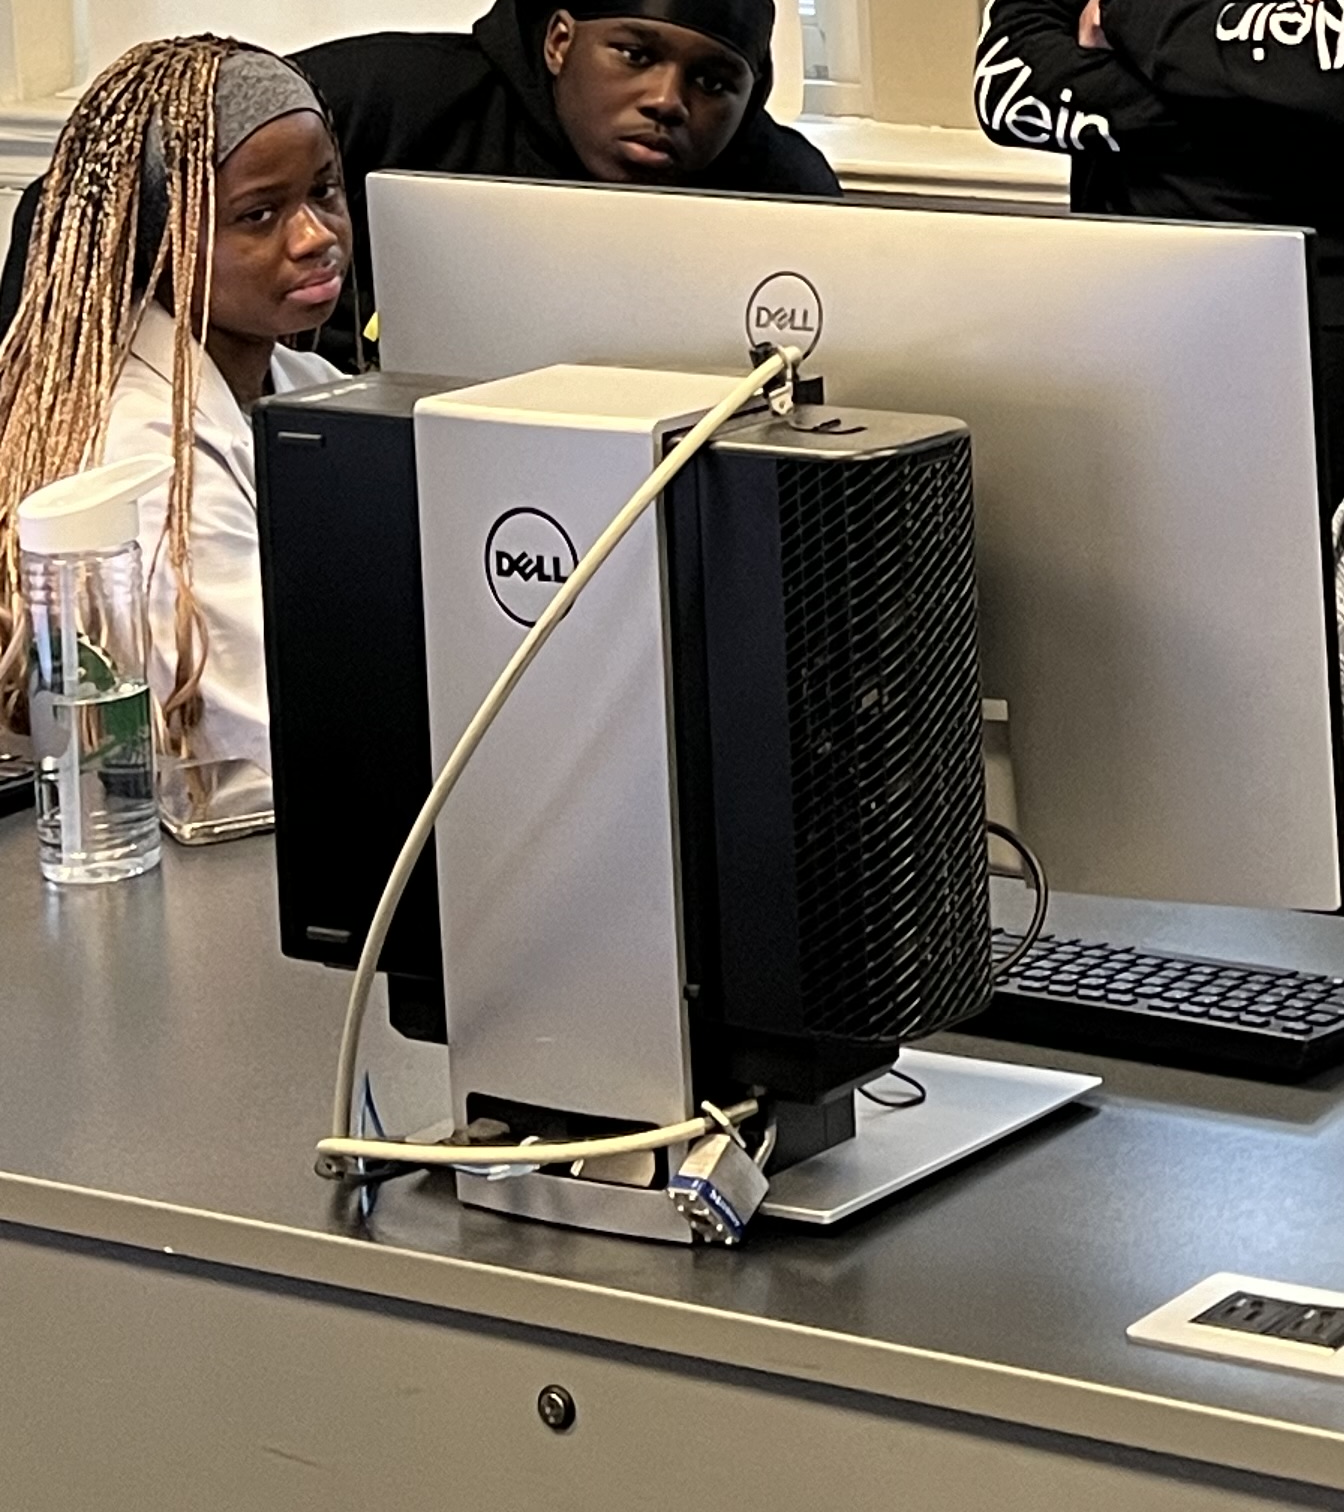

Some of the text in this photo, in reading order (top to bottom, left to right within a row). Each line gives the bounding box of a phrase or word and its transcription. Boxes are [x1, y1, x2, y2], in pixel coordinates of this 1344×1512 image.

[974, 36, 1121, 152] Klein
[755, 305, 814, 332] DELL
[495, 550, 569, 584] DELL
